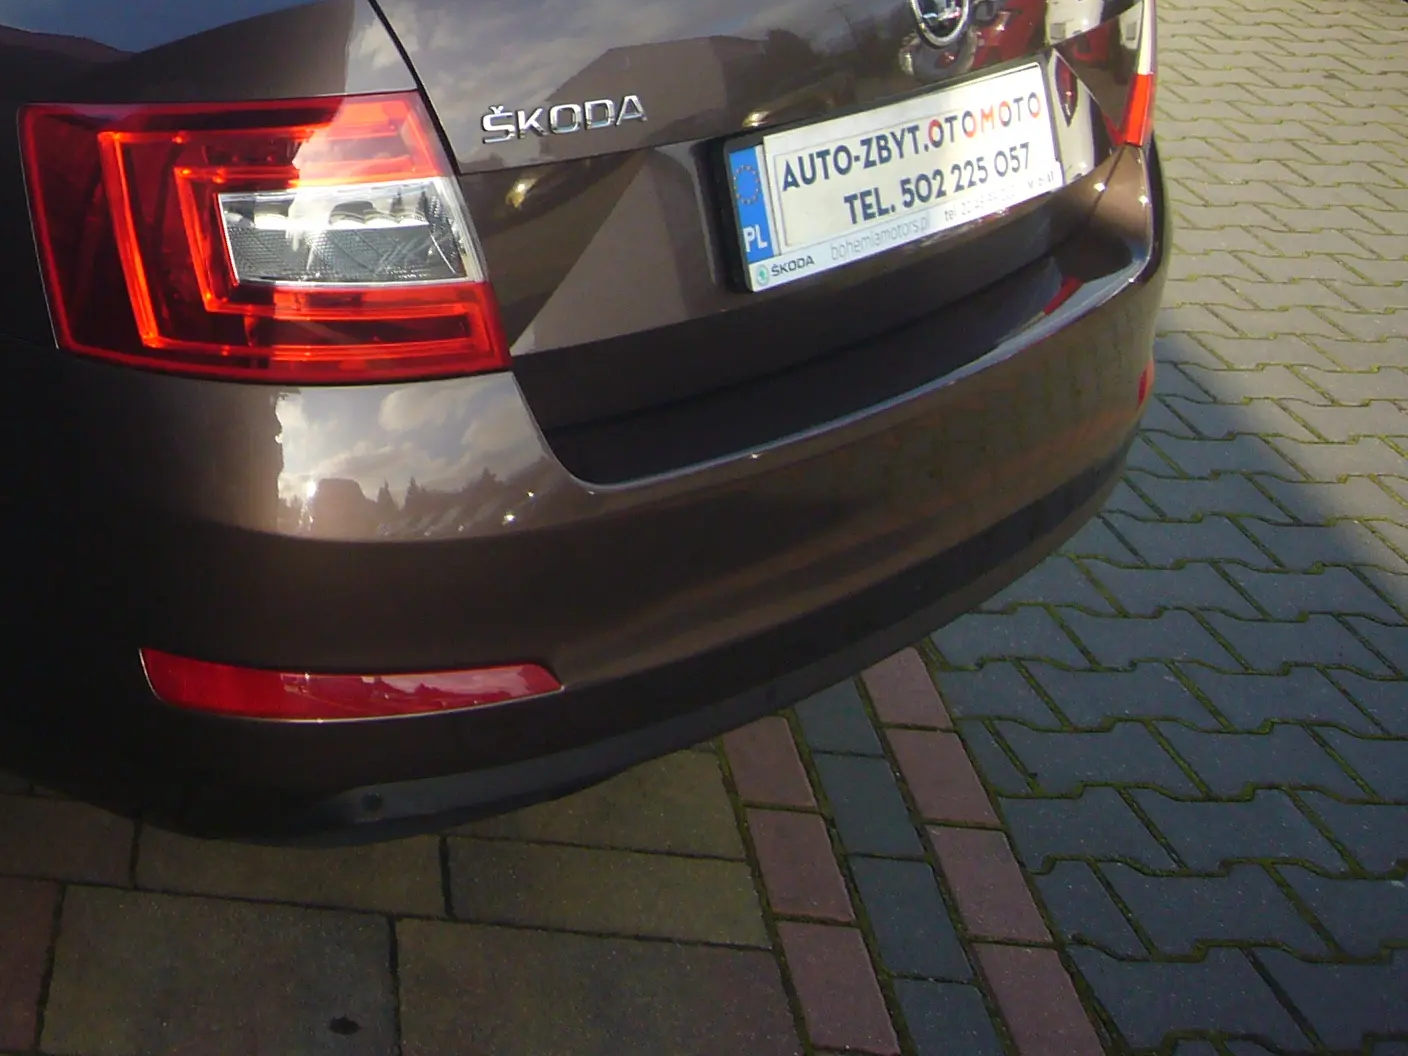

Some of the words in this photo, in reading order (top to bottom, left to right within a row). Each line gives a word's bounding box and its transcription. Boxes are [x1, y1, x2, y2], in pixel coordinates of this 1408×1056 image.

[481, 94, 648, 145] ŠKODA
[843, 187, 896, 225] TEL.
[900, 169, 947, 208] 502
[950, 156, 988, 193] 225
[994, 142, 1030, 177] 057
[742, 224, 768, 253] PL
[770, 255, 815, 277] ŠKODA
[830, 210, 931, 261] bohemiamotors.pl
